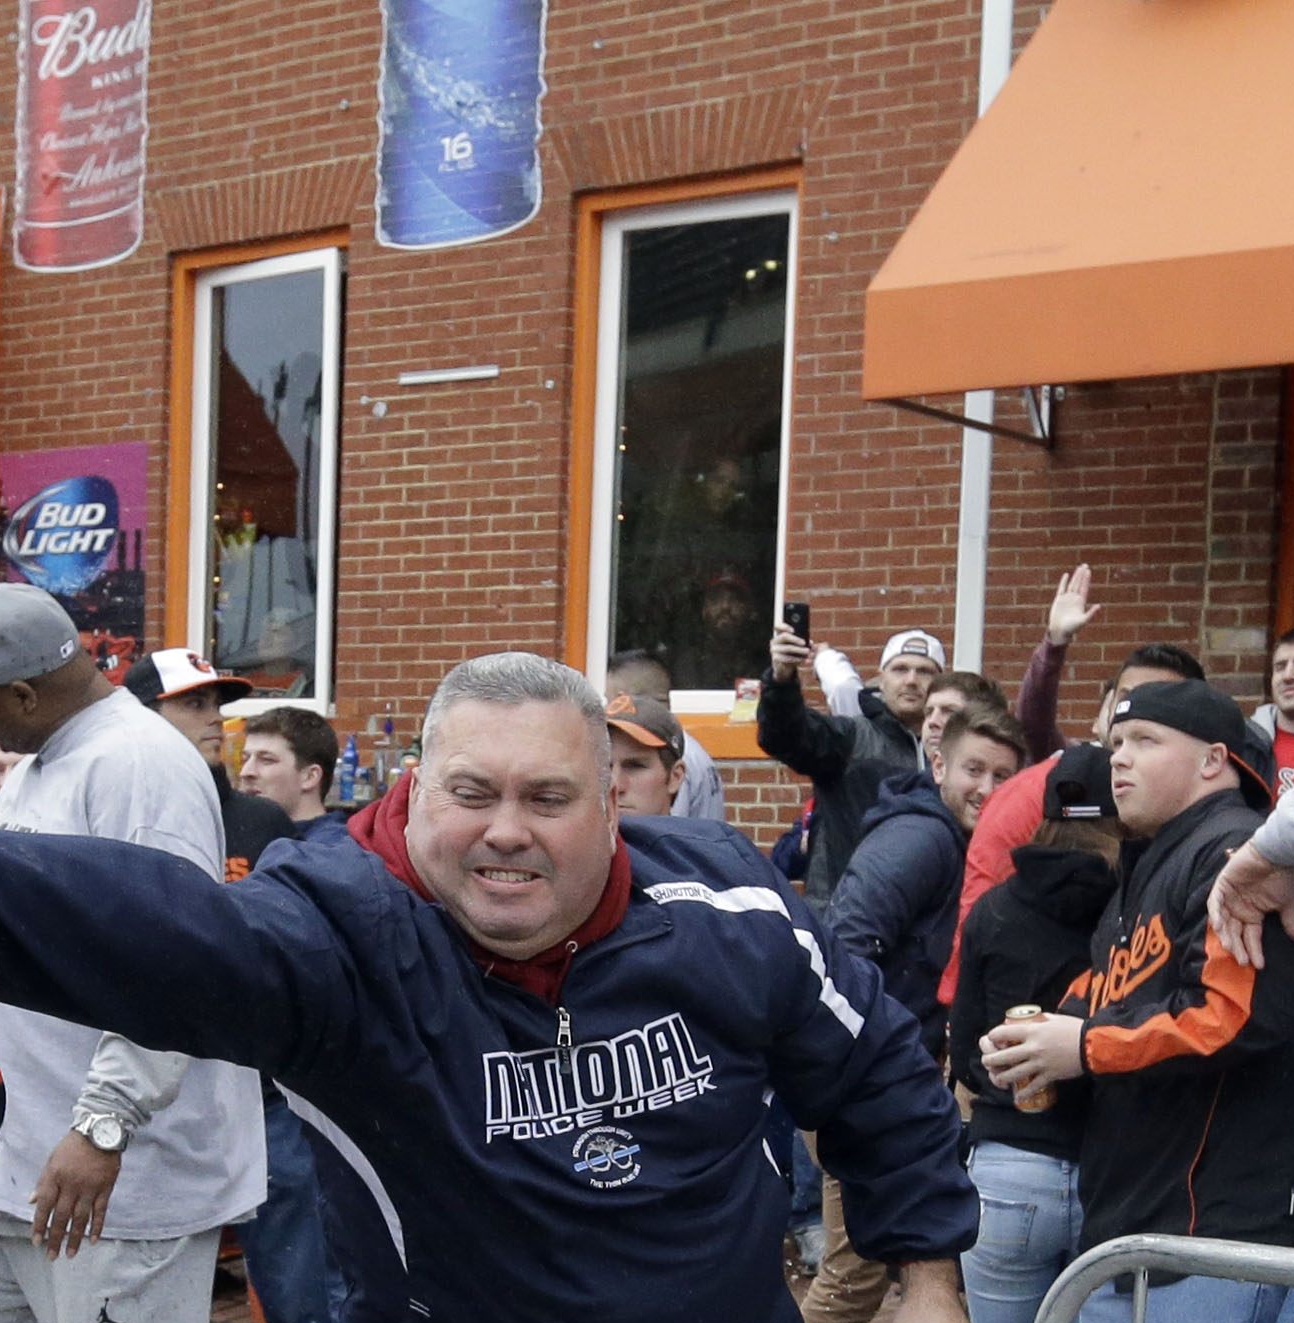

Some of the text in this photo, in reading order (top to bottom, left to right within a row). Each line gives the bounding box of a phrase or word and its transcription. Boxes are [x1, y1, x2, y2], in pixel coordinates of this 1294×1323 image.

[440, 131, 473, 161] 16
[35, 502, 106, 529] BUD
[18, 528, 116, 555] LIGHT
[486, 1074, 718, 1145] POLICE WEEK
